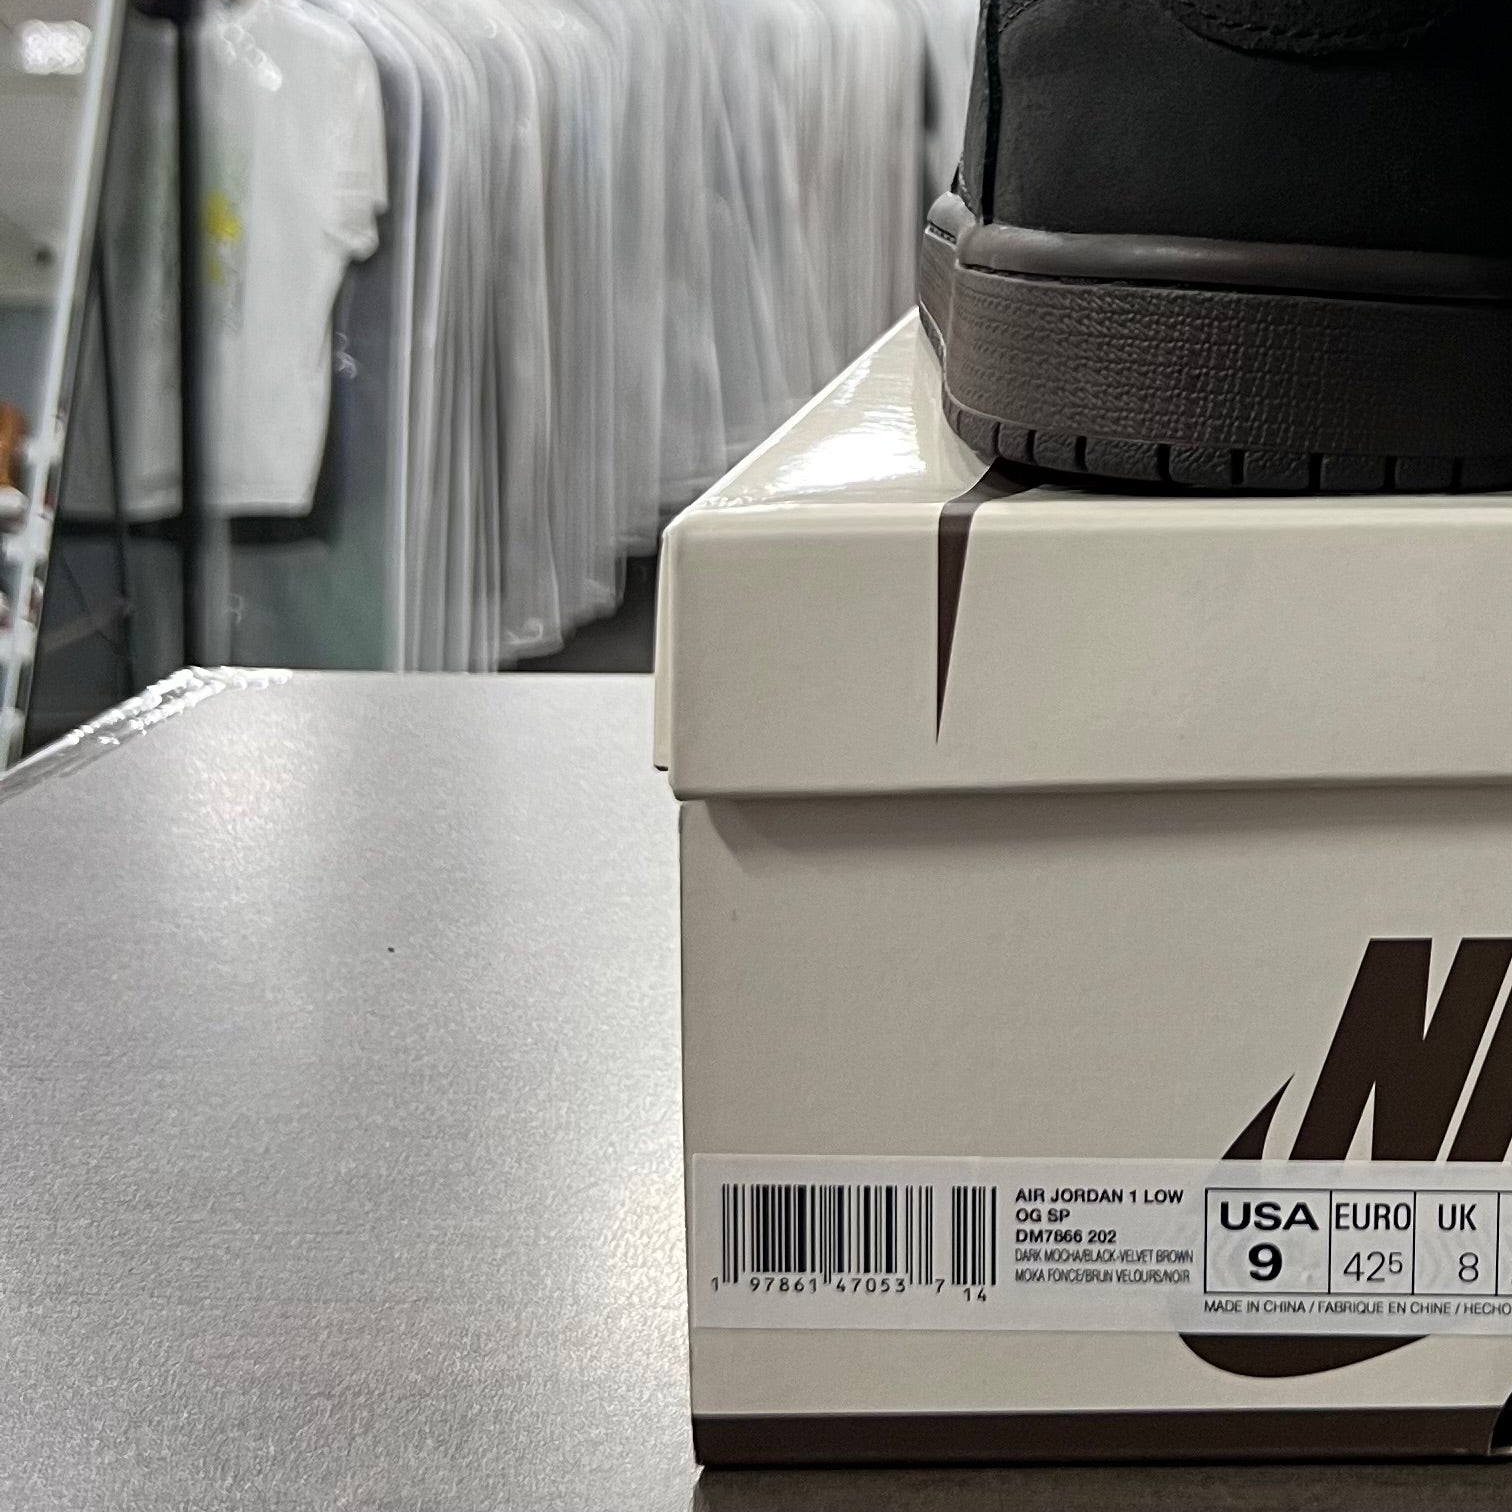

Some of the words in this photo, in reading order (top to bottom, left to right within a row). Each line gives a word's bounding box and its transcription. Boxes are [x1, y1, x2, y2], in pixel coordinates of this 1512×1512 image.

[1015, 1188, 1045, 1203] AIR
[1051, 1188, 1123, 1203] JORDAN
[1130, 1190, 1136, 1203] 1
[1144, 1189, 1183, 1204] LOW
[1016, 1208, 1041, 1223] OG
[1048, 1208, 1070, 1223] SP
[1221, 1201, 1319, 1231] USA
[1335, 1203, 1411, 1231] EURO
[1439, 1204, 1476, 1231] UK
[1016, 1229, 1082, 1244] DM7866
[1088, 1230, 1116, 1244] 202
[1015, 1248, 1042, 1262] DARK
[1156, 1249, 1193, 1264] BROWN
[1249, 1243, 1282, 1282] 9
[1459, 1252, 1478, 1283] 8
[1015, 1268, 1045, 1283] MOKA
[1116, 1269, 1190, 1284] VELOURS/NOIR
[711, 1277, 718, 1292] 1
[750, 1277, 816, 1293] 97861
[836, 1278, 905, 1294] 47053
[936, 1279, 945, 1294] 7
[964, 1285, 986, 1302] 14
[1204, 1300, 1242, 1313] MADE
[1247, 1301, 1259, 1313] IN
[1264, 1300, 1306, 1314] CHINA
[1318, 1301, 1383, 1315] FABRIQUE
[1389, 1302, 1406, 1315] EN
[1410, 1302, 1450, 1316] CHINE
[1464, 1302, 1512, 1316] HECHO
